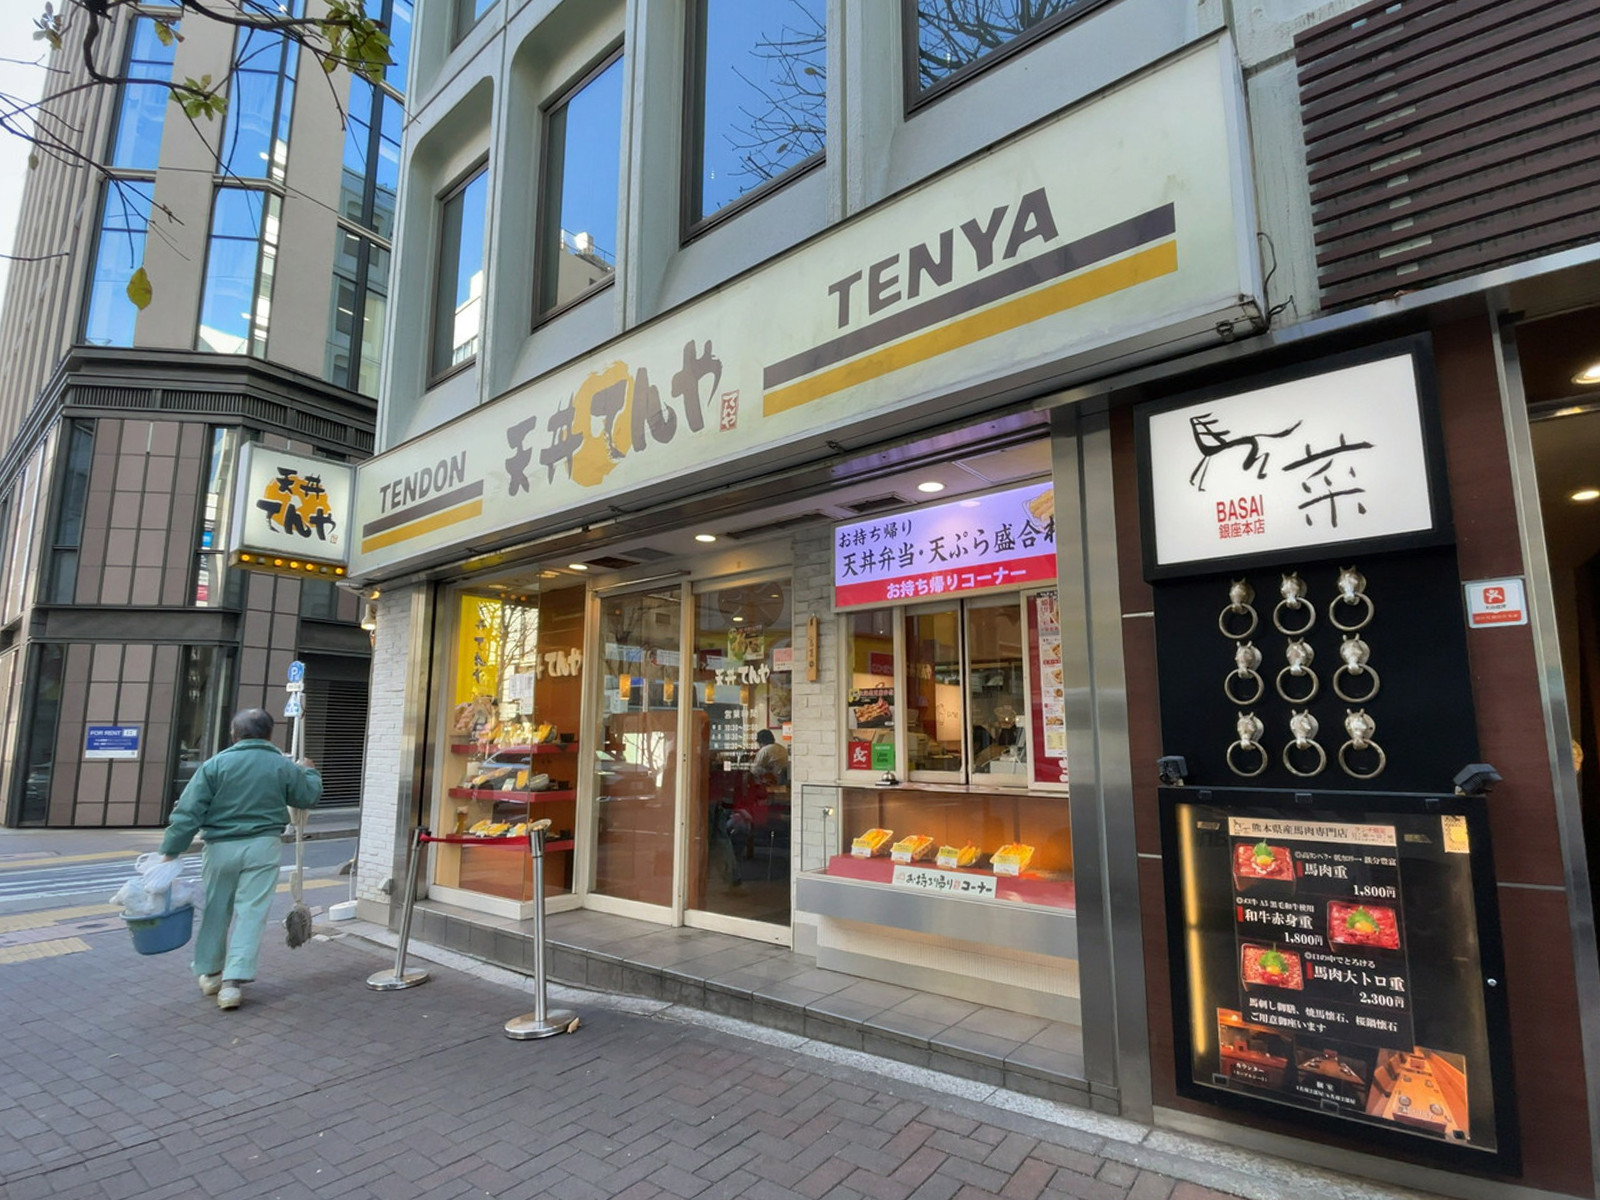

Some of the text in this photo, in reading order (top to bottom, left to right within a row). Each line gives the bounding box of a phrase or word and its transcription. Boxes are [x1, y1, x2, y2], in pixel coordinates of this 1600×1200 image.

[828, 187, 1059, 329] TENYA
[379, 451, 467, 513] TENDON
[1216, 495, 1264, 522] BASAI
[256, 499, 337, 541] てんや
[1218, 518, 1265, 539] 銀座本店
[839, 519, 912, 549] お持ち帰り
[887, 568, 1026, 599] お持ち帰りコーナー
[1250, 822, 1348, 840] 熊本県産馬肉専門店
[1304, 862, 1348, 880] 馬肉重
[961, 880, 993, 894] コーナー
[1352, 884, 1396, 899] 1,800円
[1244, 908, 1313, 930] 和牛赤身重
[1284, 931, 1324, 946] 1,800円
[1313, 965, 1405, 992] 馬肉大トロ重
[1359, 991, 1405, 1009] 2,300円
[1250, 1011, 1327, 1033] ご用意御座います
